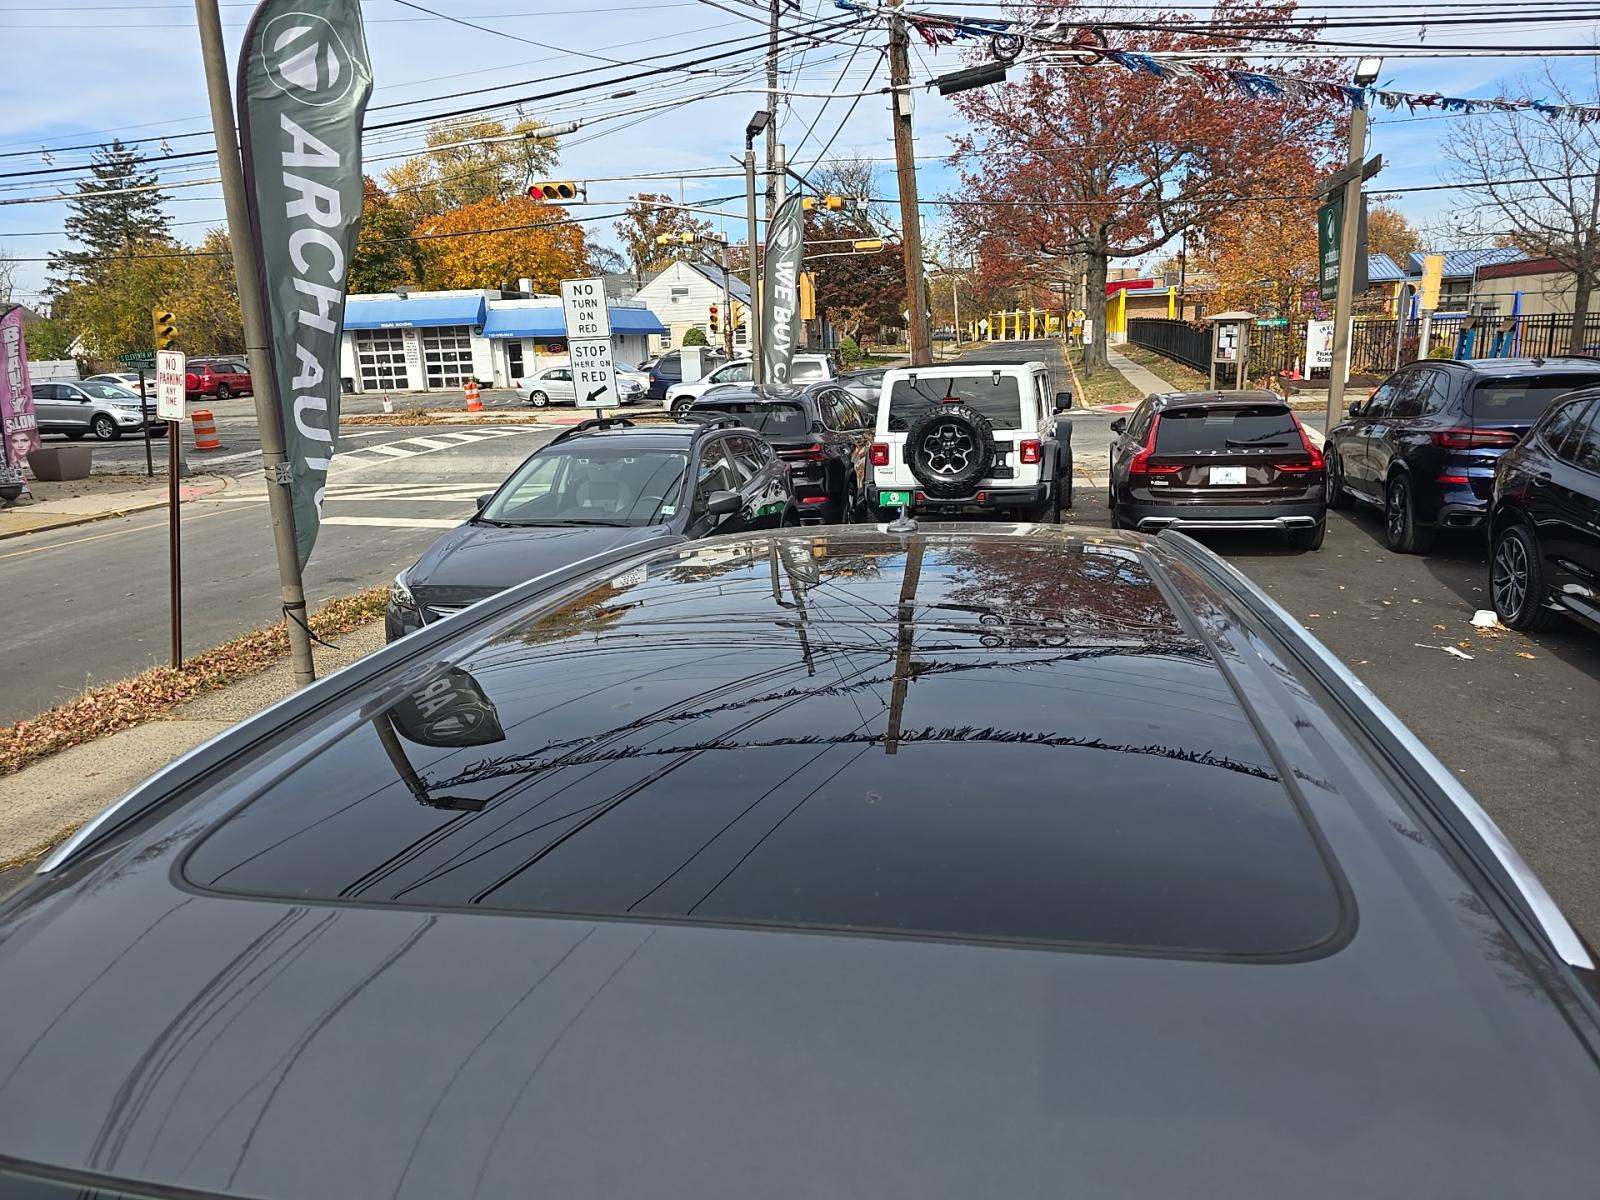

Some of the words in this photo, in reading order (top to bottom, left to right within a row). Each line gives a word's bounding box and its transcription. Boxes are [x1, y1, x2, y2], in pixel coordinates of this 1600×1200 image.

[280, 112, 343, 335] ARCH
[774, 261, 795, 301] WE
[573, 284, 593, 296] NO
[572, 299, 598, 309] TURN
[579, 312, 594, 321] ON
[578, 324, 598, 333] RED
[773, 306, 793, 358] BUY
[1319, 324, 1333, 334] IRVI
[575, 345, 607, 357] STOP
[165, 358, 177, 370] NO
[574, 360, 595, 368] HERE
[159, 372, 183, 386] PARKING
[581, 371, 607, 382] RED
[166, 387, 177, 395] ANY
[165, 396, 177, 406] TIME
[5, 415, 36, 434] SLON
